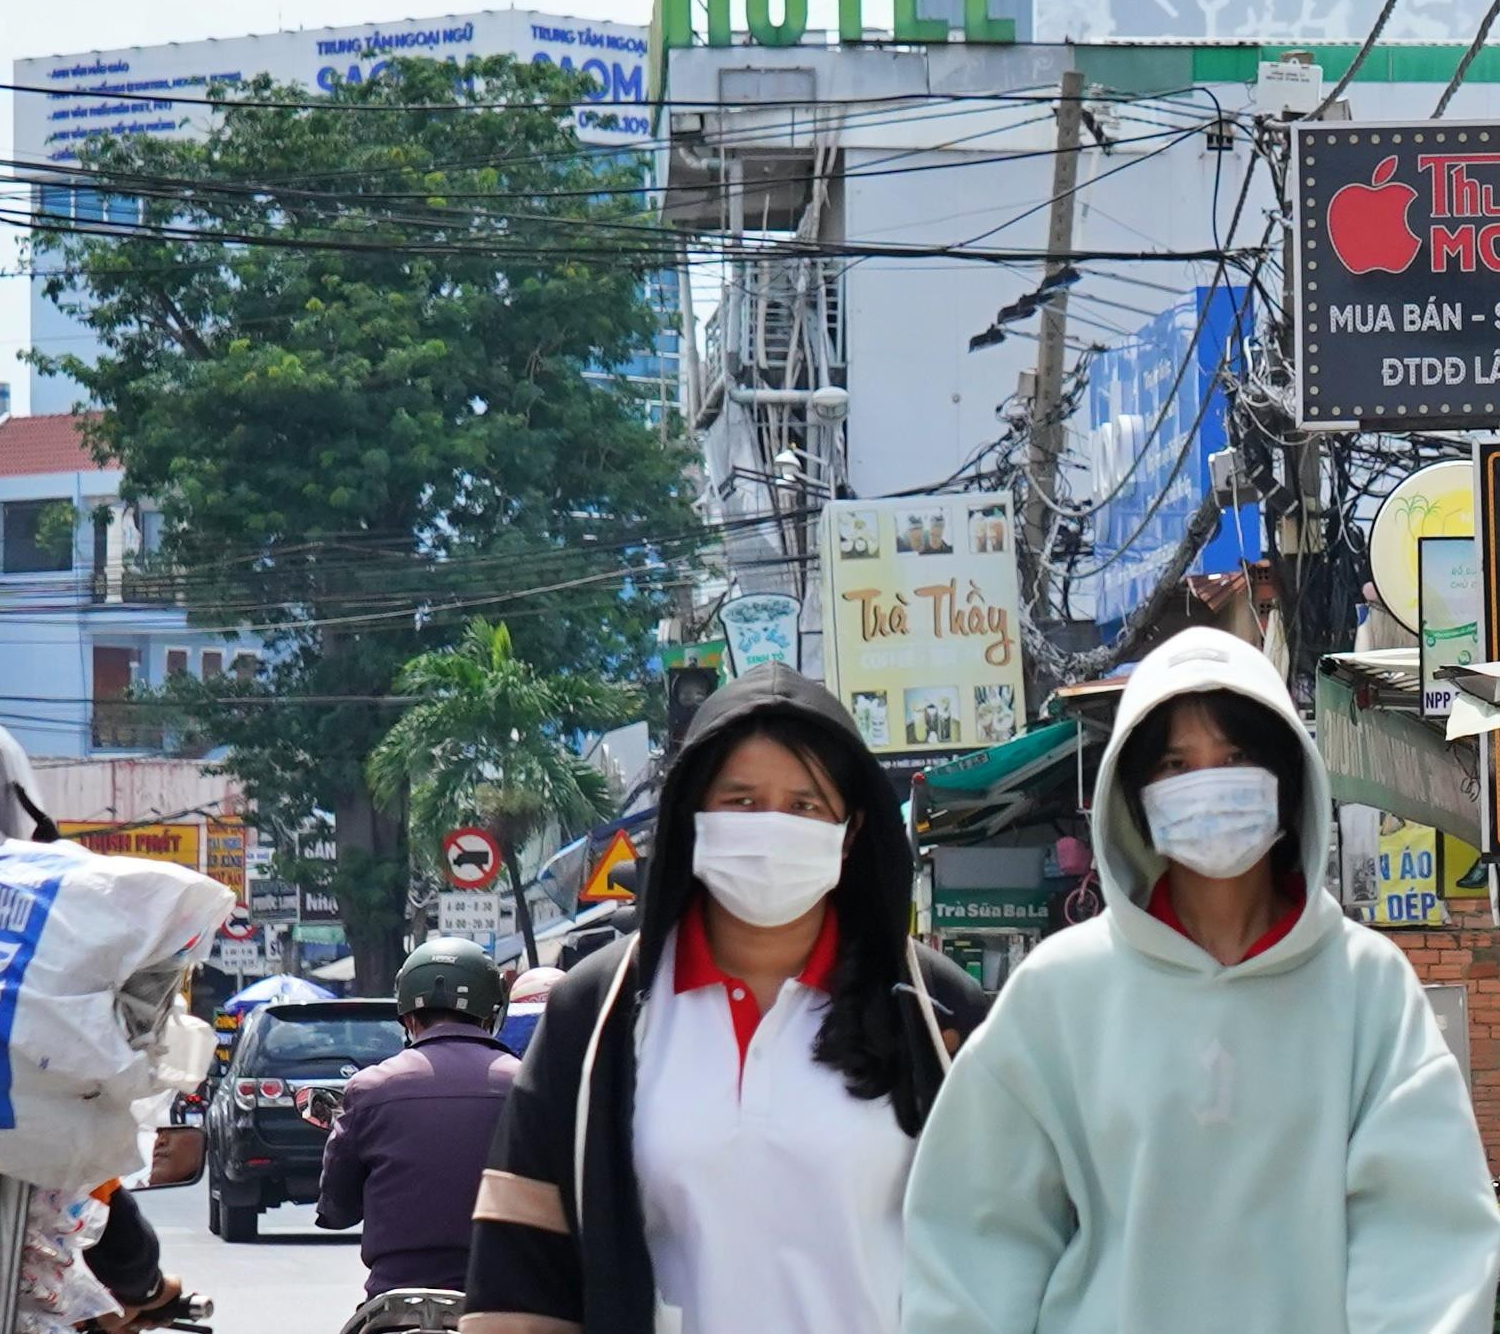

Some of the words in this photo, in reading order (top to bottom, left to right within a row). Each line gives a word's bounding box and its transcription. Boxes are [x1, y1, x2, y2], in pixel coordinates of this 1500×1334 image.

[316, 37, 362, 57] TRUNG
[365, 29, 393, 52] TÂM
[1329, 303, 1396, 334] MUA
[1403, 295, 1463, 332] BÁN
[1381, 356, 1467, 387] ĐTDĐ
[842, 587, 911, 644] Trà
[913, 576, 1018, 667] Thầy
[1425, 690, 1451, 709] NPP
[1399, 845, 1433, 880] ÁO
[935, 899, 967, 918] Trà
[1387, 887, 1436, 921] DÉP
